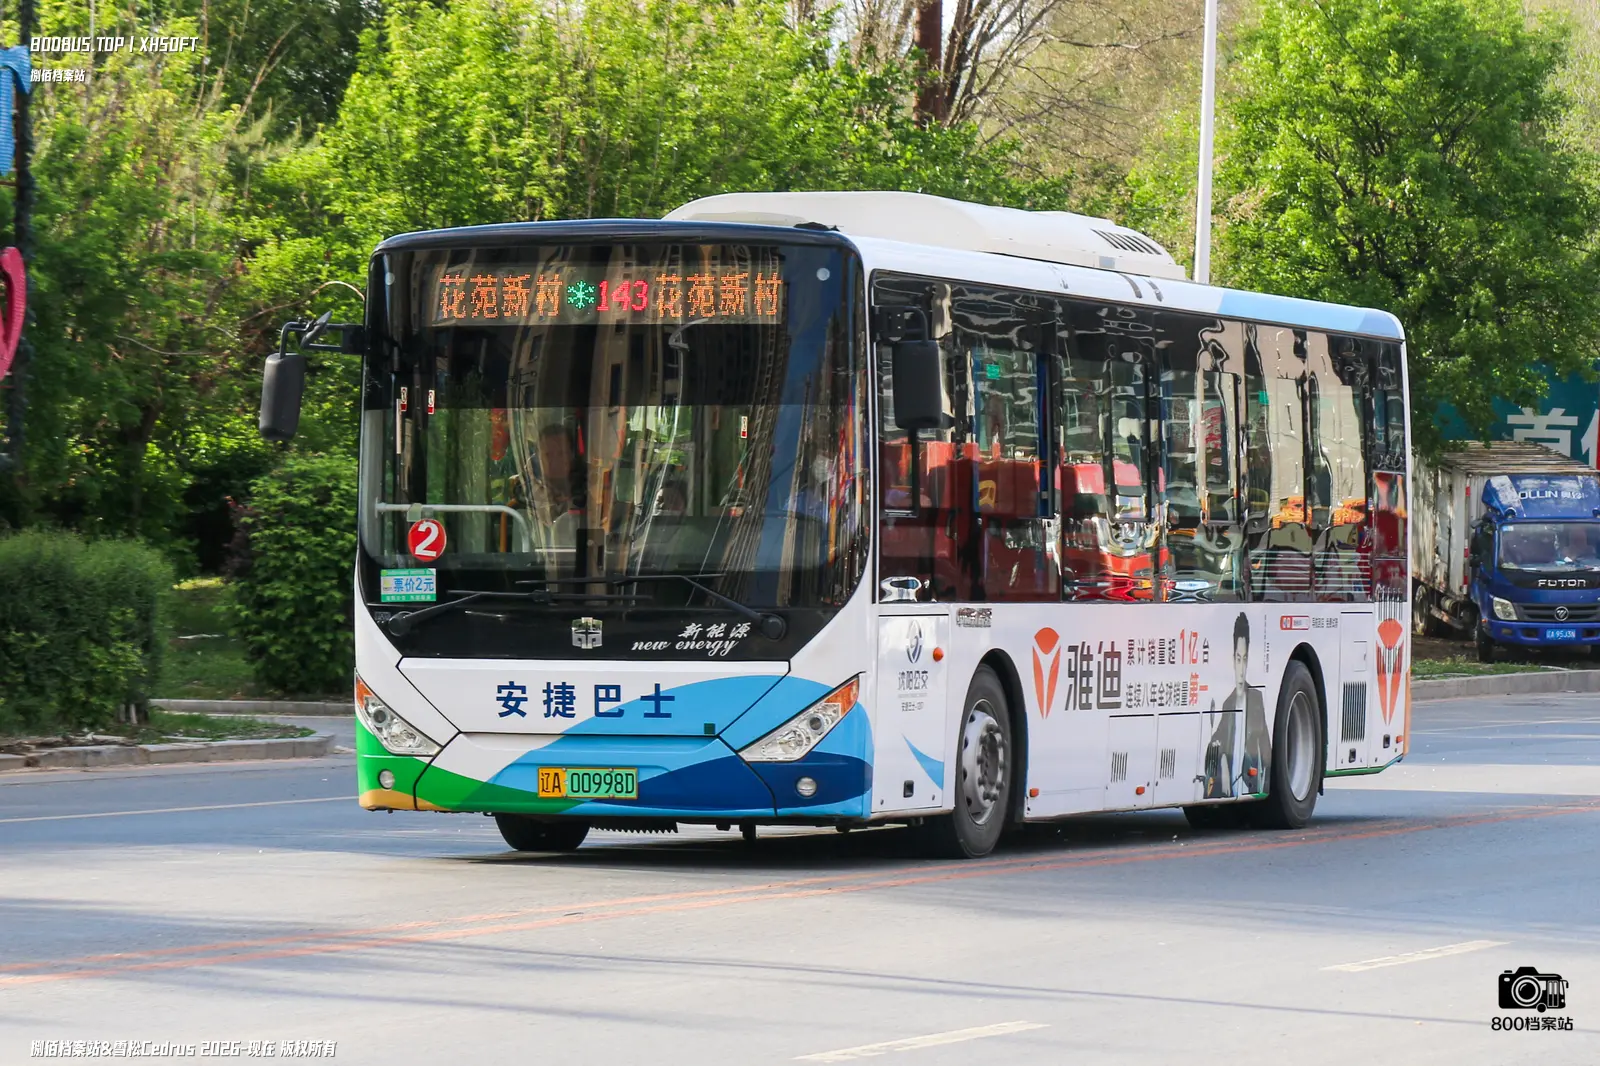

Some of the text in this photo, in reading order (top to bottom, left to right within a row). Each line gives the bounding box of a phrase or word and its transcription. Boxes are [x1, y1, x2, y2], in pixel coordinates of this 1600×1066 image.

[439, 272, 783, 318] 花苑新村 143 花苑新村
[1507, 407, 1599, 470] 首
[414, 521, 439, 557] 2
[393, 577, 435, 592] 票价2元
[1538, 579, 1587, 587] FOTON
[677, 622, 752, 639] 新能源
[631, 639, 740, 657] new energy
[1065, 641, 1122, 711] 雅迪
[495, 681, 676, 719] 安捷巴士
[570, 771, 635, 795] 00998D
